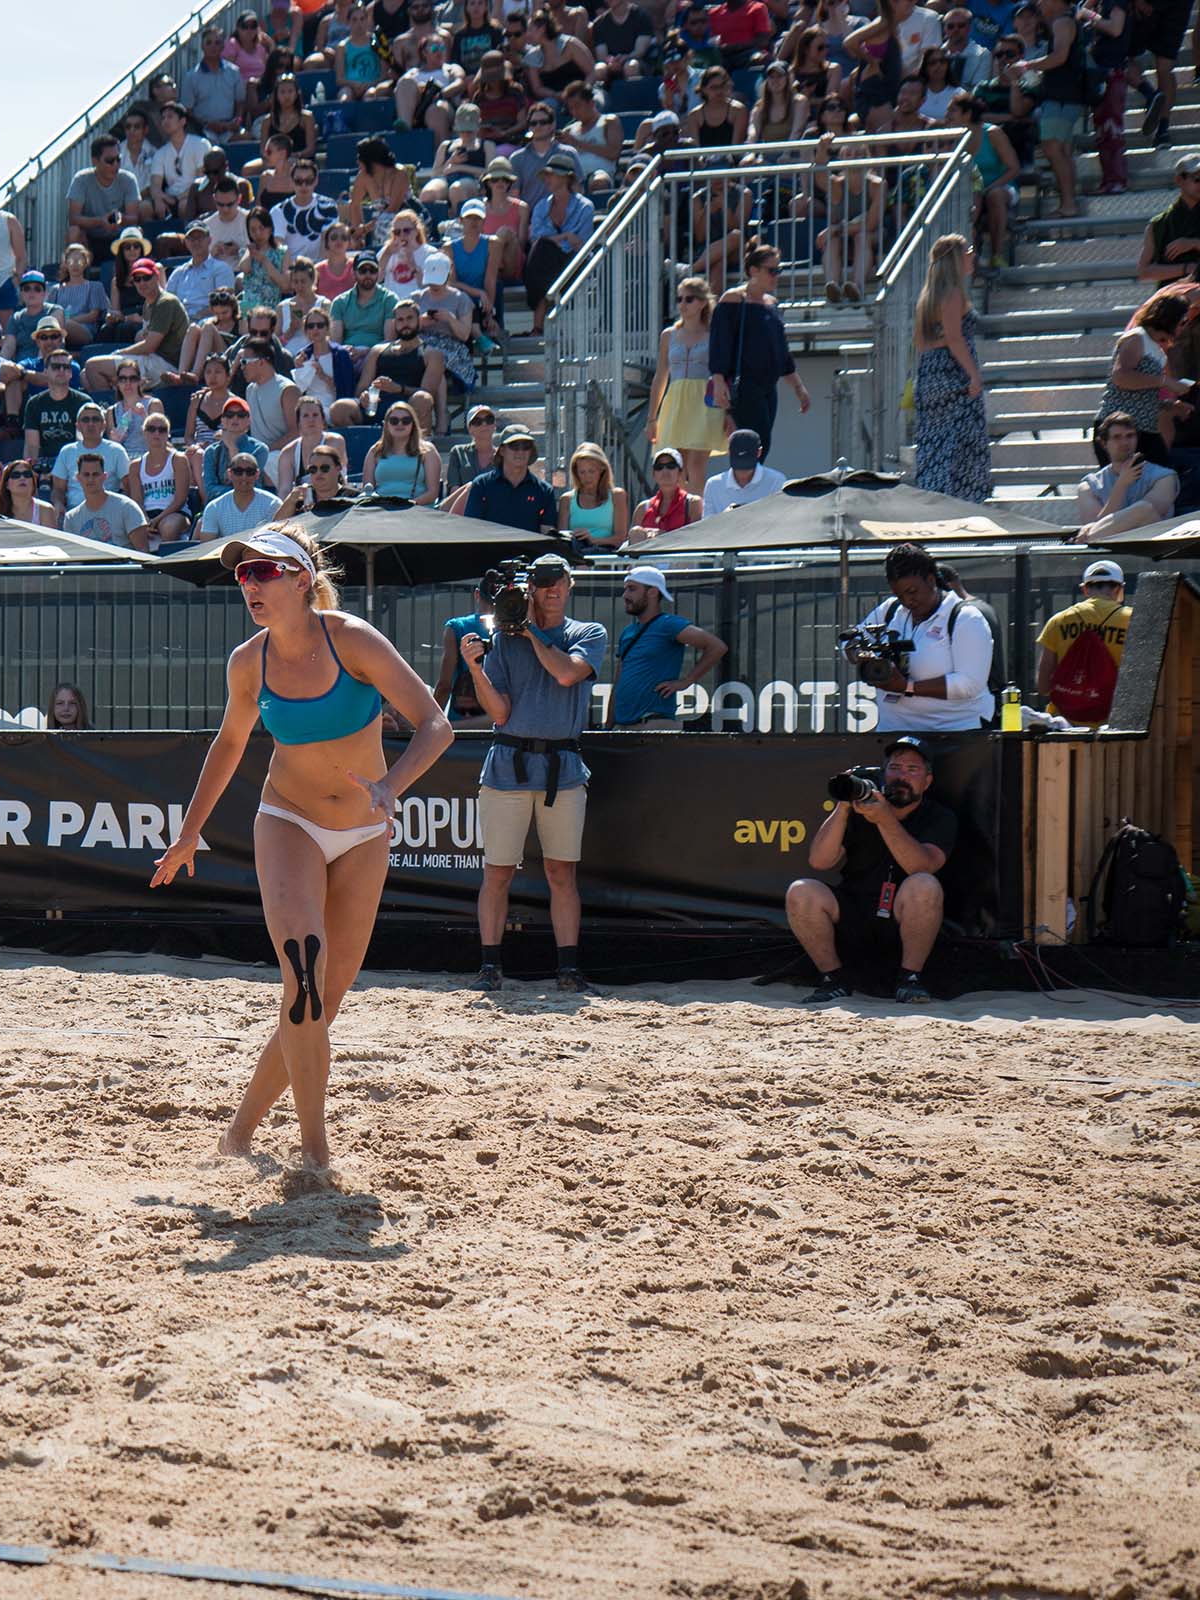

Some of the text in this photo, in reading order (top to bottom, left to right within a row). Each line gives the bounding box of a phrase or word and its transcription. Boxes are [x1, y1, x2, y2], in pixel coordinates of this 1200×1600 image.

[734, 820, 806, 852] avp
[402, 854, 420, 868] ALL
[423, 855, 452, 868] MORE
[453, 855, 480, 869] THAN
